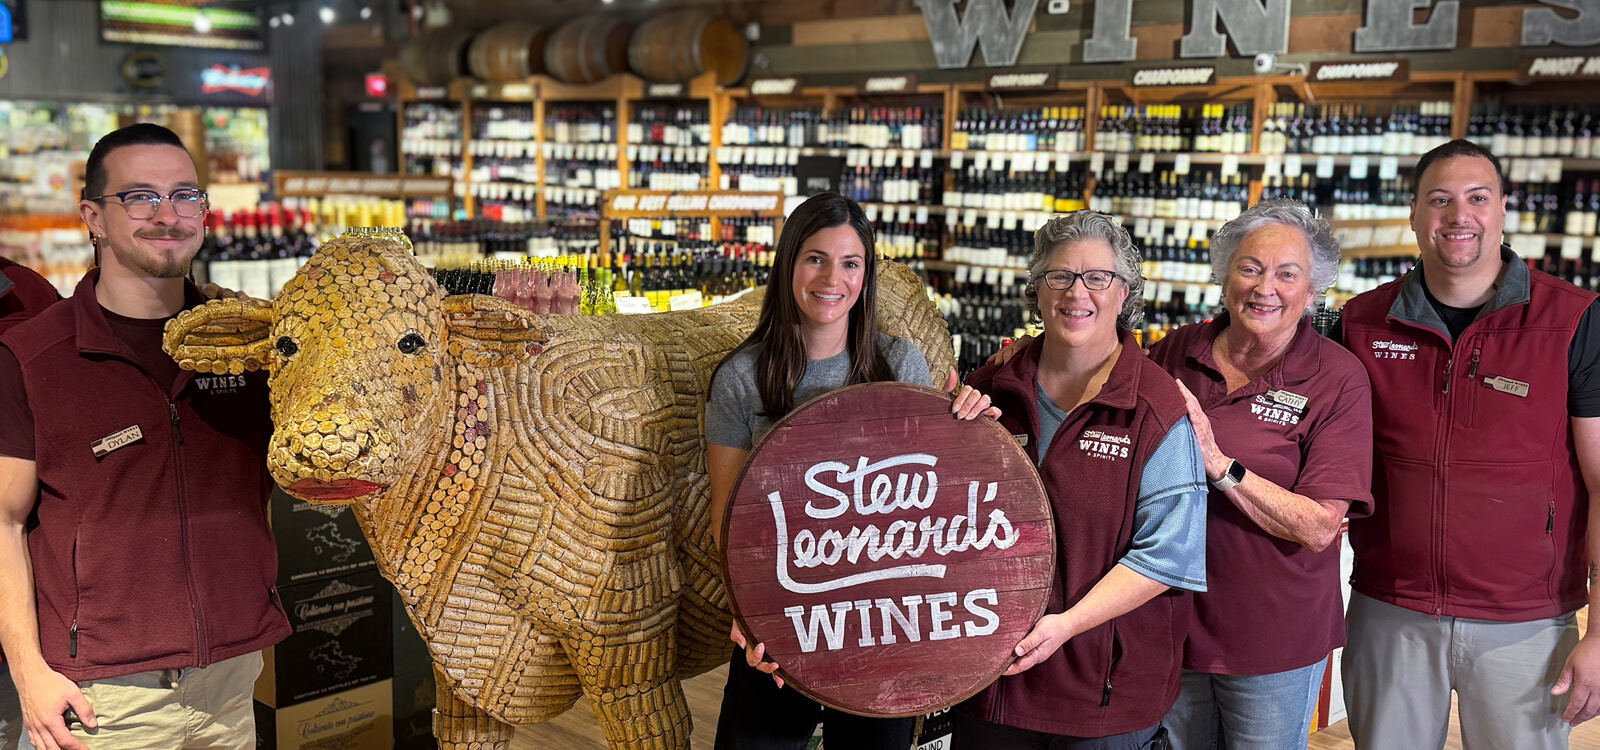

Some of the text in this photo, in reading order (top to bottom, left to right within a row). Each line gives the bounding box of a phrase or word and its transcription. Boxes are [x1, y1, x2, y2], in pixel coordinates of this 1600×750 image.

[1528, 56, 1585, 75] PINOT
[1133, 68, 1214, 85] CHARDONNAY
[613, 195, 638, 211] OUR
[638, 195, 667, 211] BEST
[666, 194, 708, 211] SELLING
[1374, 351, 1416, 360] WINES
[195, 375, 247, 390] WINES
[1503, 383, 1520, 392] JEFF
[1277, 394, 1304, 407] CATHY
[1250, 402, 1300, 425] WINES
[107, 431, 140, 449] DYLAN
[1079, 439, 1129, 459] WINES
[1092, 452, 1116, 462] SPIRITS
[804, 453, 939, 519] Stew
[767, 481, 1020, 594] Leonard's
[784, 588, 1000, 653] WINES
